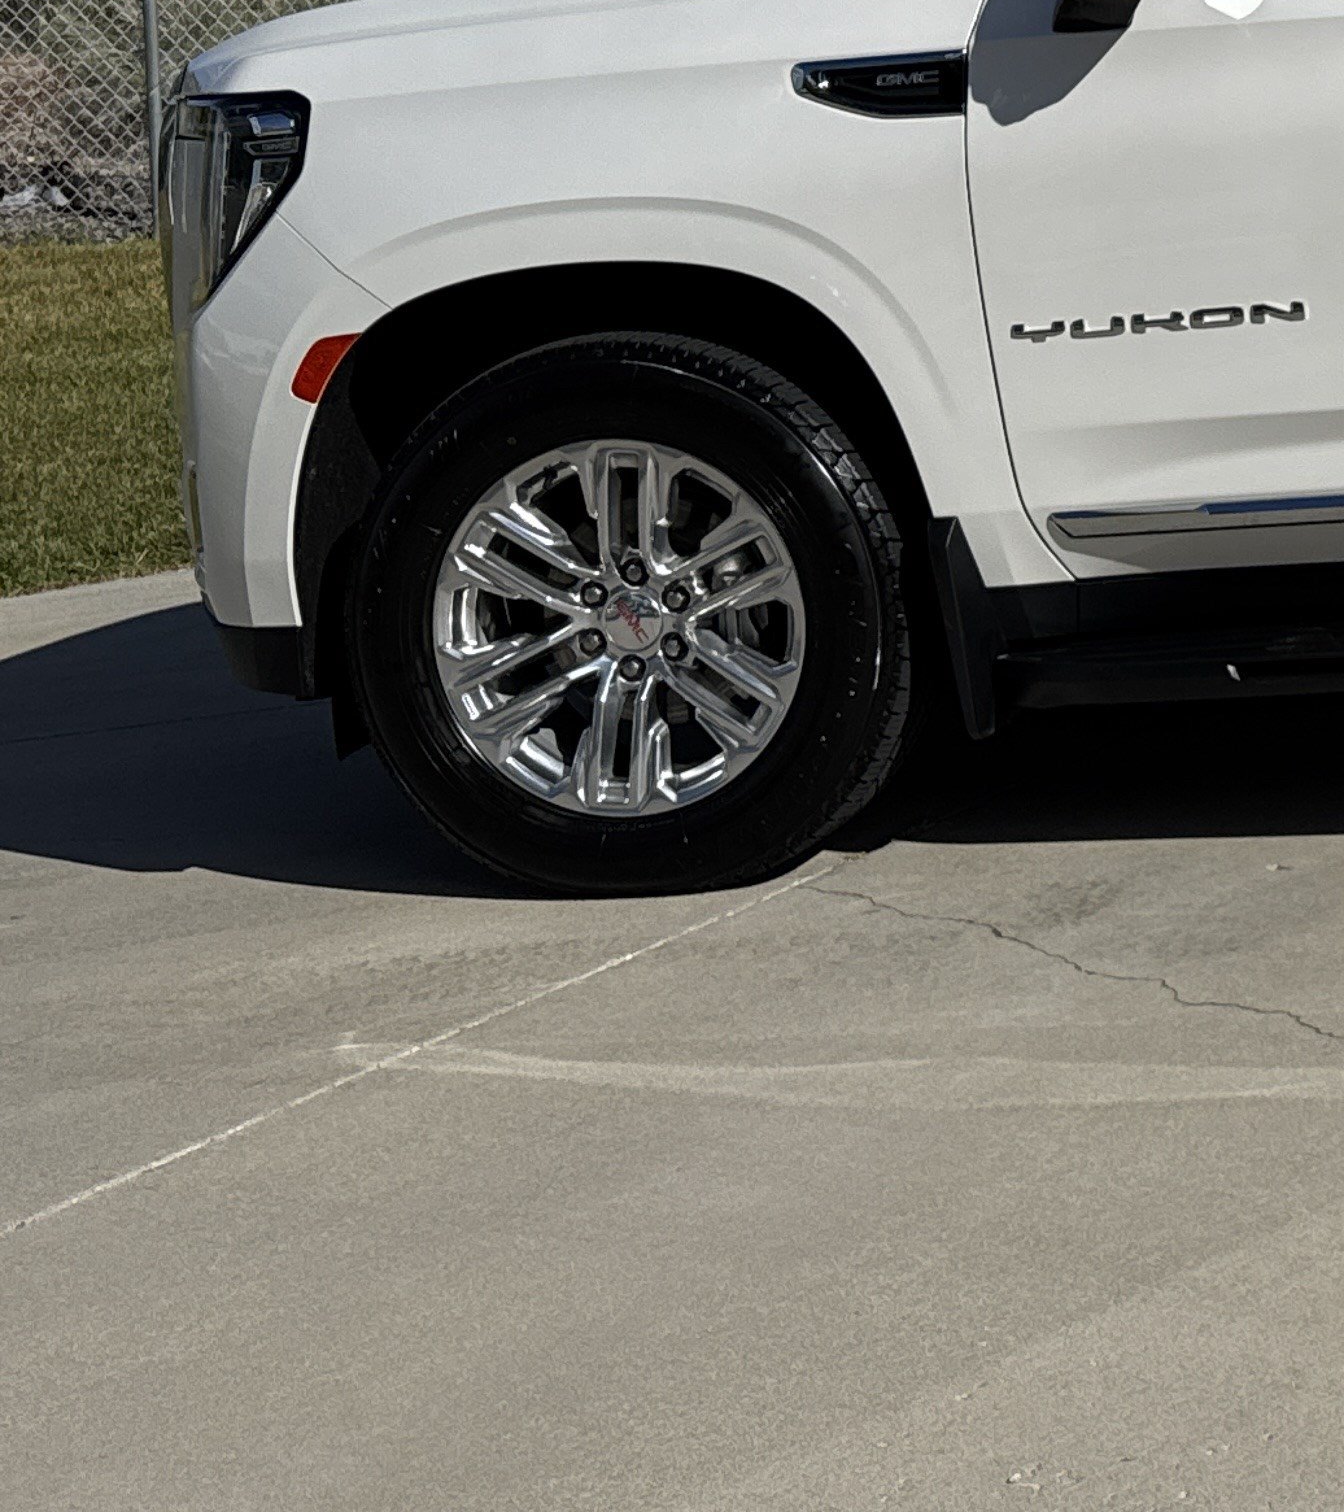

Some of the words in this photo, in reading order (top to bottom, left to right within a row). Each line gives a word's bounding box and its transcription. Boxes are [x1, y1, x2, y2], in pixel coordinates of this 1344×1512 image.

[876, 70, 939, 87] GMC
[1010, 301, 1306, 344] YUKON
[615, 598, 651, 644] GMC
